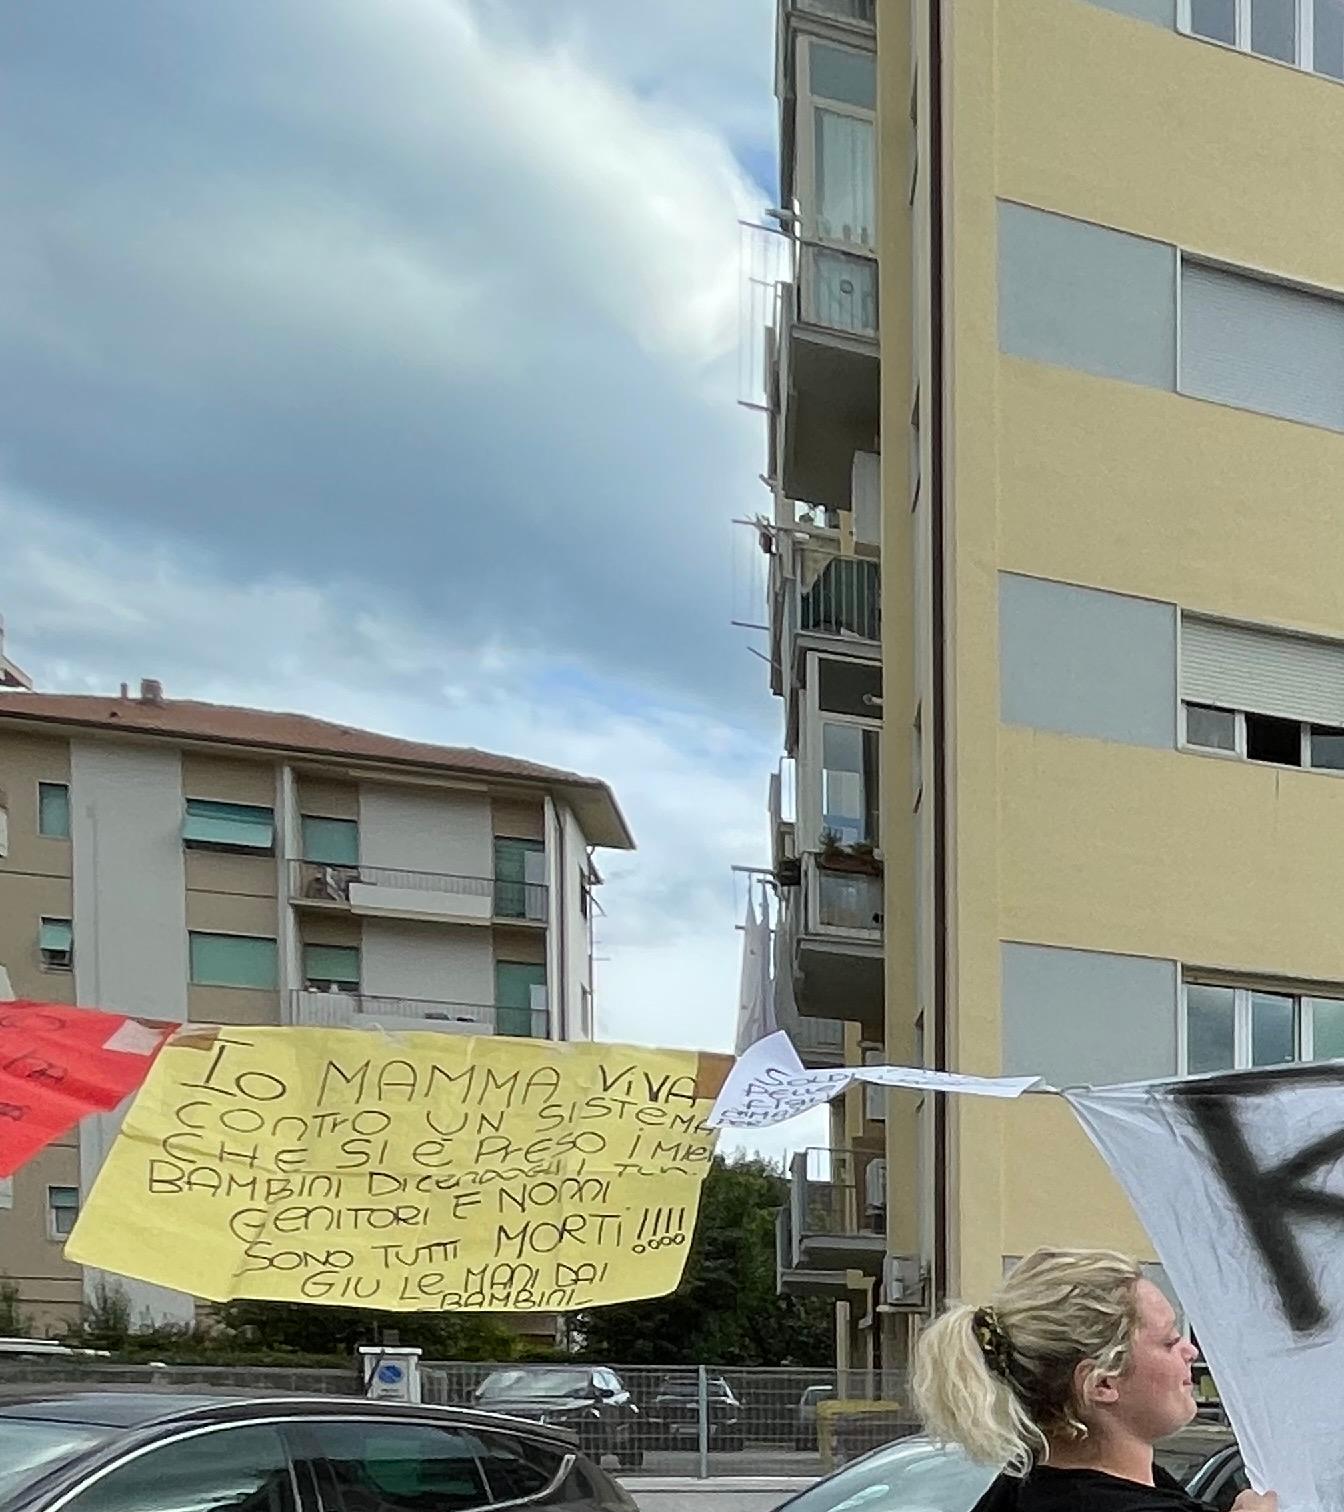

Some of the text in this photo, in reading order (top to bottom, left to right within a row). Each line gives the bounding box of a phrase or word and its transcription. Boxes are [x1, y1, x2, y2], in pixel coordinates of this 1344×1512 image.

[178, 1038, 697, 1108] Io MAMMA ViVA
[426, 1110, 505, 1136] UN
[162, 1132, 309, 1174] CHE
[336, 1138, 389, 1170] SI
[148, 1158, 342, 1206] BAMBINI
[451, 1190, 483, 1220] E
[232, 1241, 355, 1278] SONO
[371, 1239, 461, 1269] TUTTI
[464, 1261, 541, 1295] MANI
[554, 1261, 609, 1289] DAI
